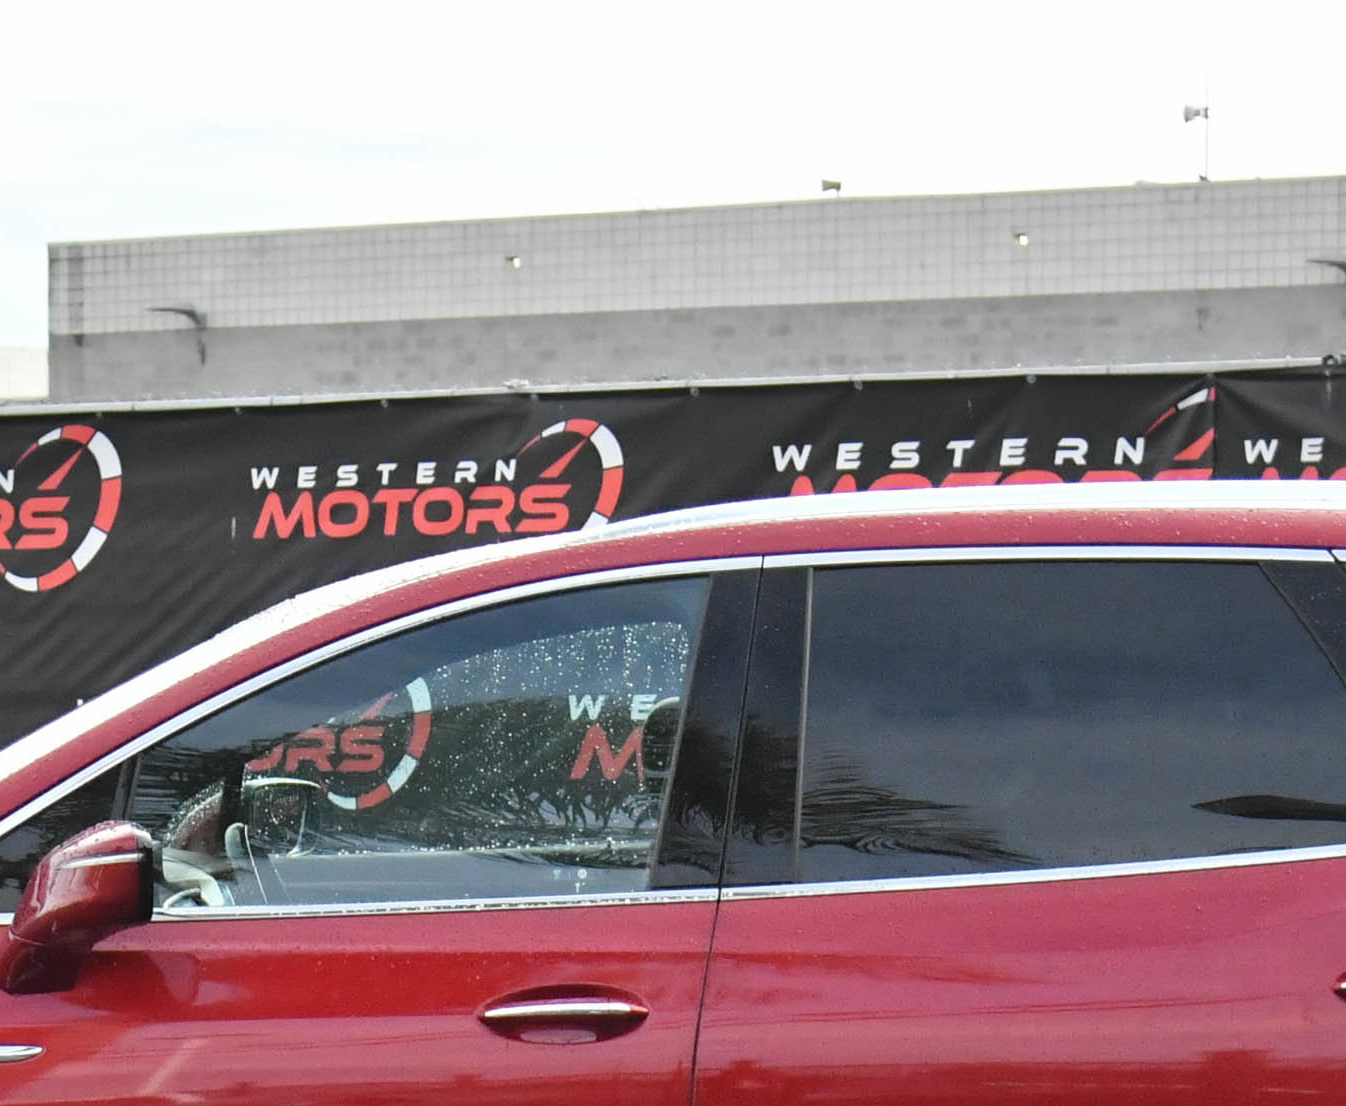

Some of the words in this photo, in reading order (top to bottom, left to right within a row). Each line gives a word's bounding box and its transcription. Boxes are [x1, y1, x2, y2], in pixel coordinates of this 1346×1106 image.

[772, 436, 1146, 473] WESTERN
[250, 458, 518, 490] WESTERN
[252, 483, 572, 540] MOTORS
